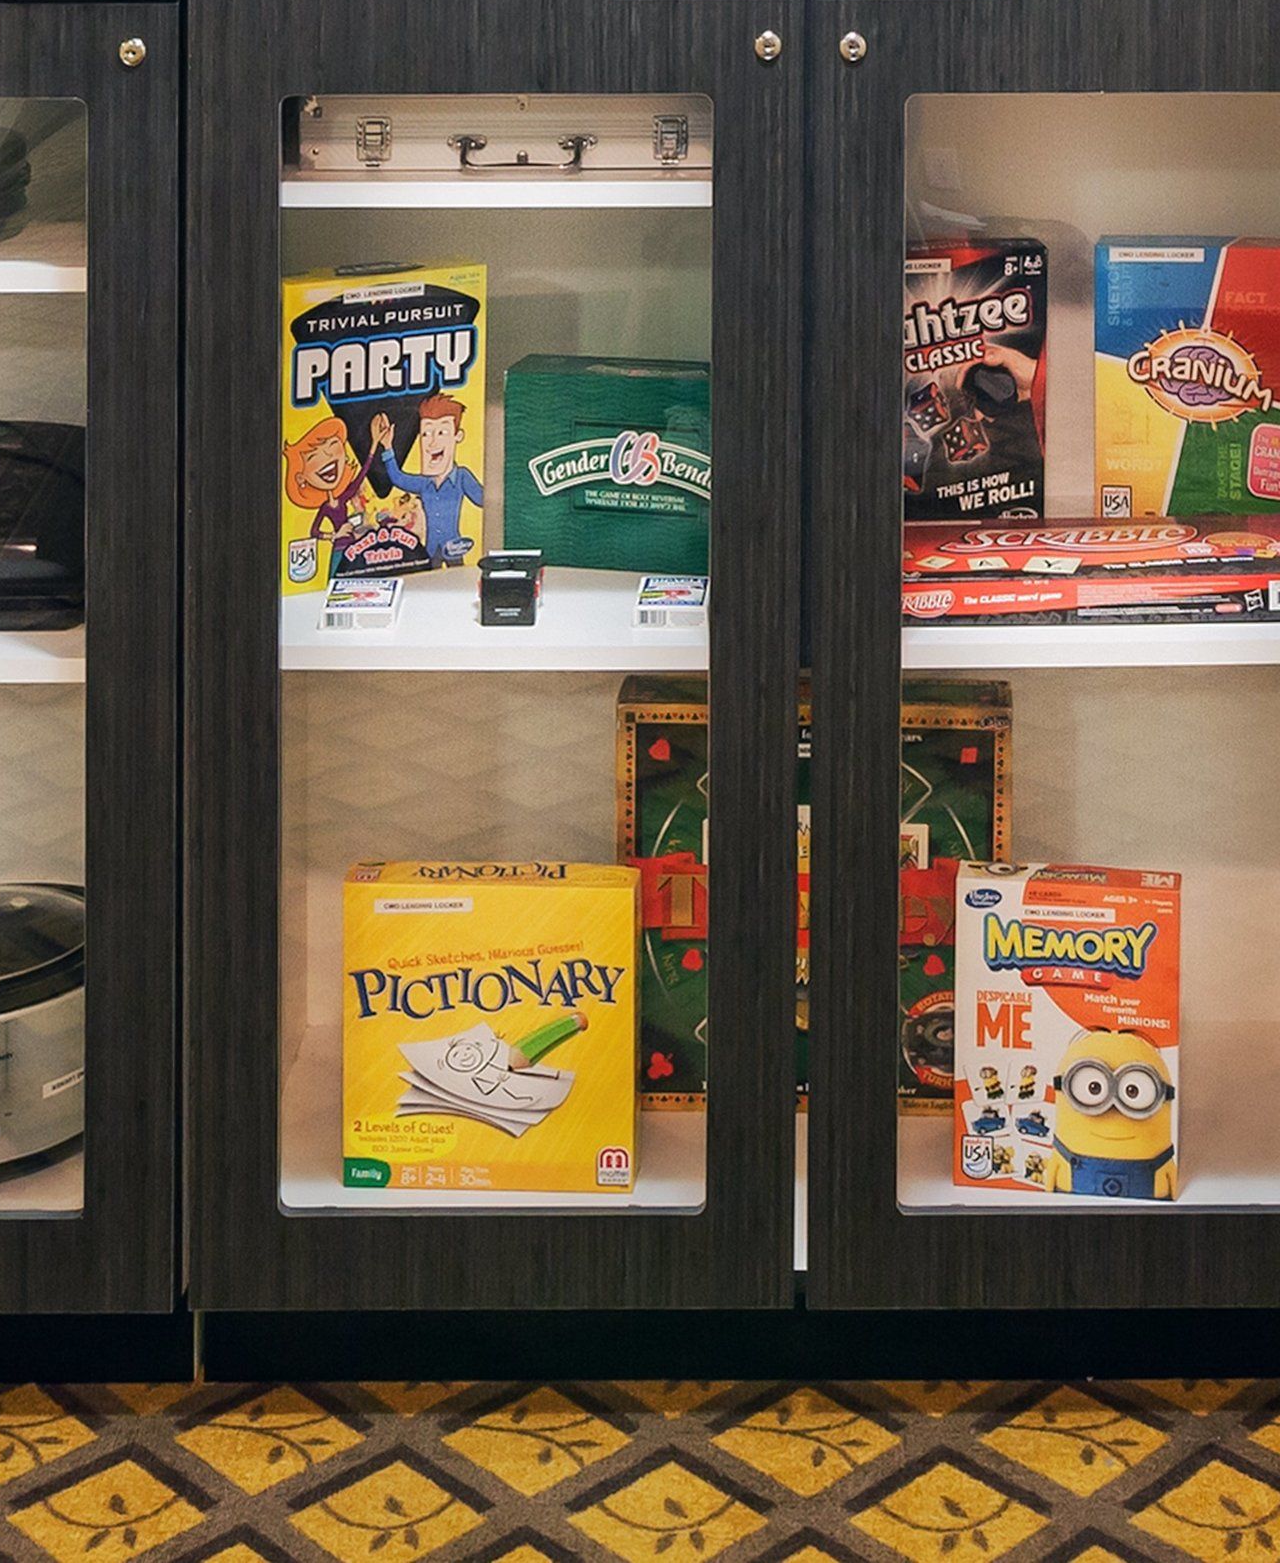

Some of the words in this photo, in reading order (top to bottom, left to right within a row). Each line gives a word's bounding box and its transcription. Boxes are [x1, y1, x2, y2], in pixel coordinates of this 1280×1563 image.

[363, 289, 393, 299] LENDING
[395, 286, 423, 296] LOCKER
[1224, 291, 1268, 305] FACT
[306, 313, 380, 334] TRIVIAL
[384, 303, 465, 325] PURSUIT
[905, 338, 985, 373] CLASSIC
[296, 329, 471, 401] PARTY
[542, 450, 610, 485] Gender
[660, 451, 712, 488] Bend
[936, 481, 966, 499] THIS
[967, 479, 980, 493] IS
[981, 471, 1010, 489] HOW
[958, 491, 986, 512] WE
[988, 480, 1035, 506] ROLL!
[1104, 494, 1129, 511] USA
[344, 533, 376, 561] Fast
[377, 528, 389, 543] &
[390, 527, 419, 550] Fun
[963, 528, 1187, 547] SCRABBLE
[290, 547, 315, 567] USA
[363, 545, 403, 565] Trivia
[963, 596, 978, 605] The
[979, 594, 1016, 604] CLASSIC
[1017, 592, 1038, 602] word
[1039, 592, 1063, 603] game
[434, 901, 464, 910] LOCKER
[1102, 894, 1126, 904] AGES
[1075, 911, 1105, 919] LOCKER
[986, 915, 1154, 969] MEMORY
[387, 957, 421, 970] Quick
[425, 951, 486, 967] Sketches,
[488, 946, 535, 960] Hilarious
[537, 939, 585, 956] Guesses!
[1031, 968, 1103, 983] GAME
[348, 957, 626, 1020] PICTIONARY
[976, 990, 1033, 1004] DESPICABLE
[1083, 993, 1118, 1005] Match
[1119, 998, 1142, 1008] your
[1101, 1004, 1137, 1016] favorite
[976, 1003, 1034, 1050] ME
[1117, 1015, 1171, 1029] MINIONS!
[353, 1120, 362, 1132] 2
[365, 1121, 400, 1134] Levels
[403, 1120, 417, 1134] of
[419, 1122, 455, 1135] Clues!
[964, 1144, 992, 1162] USA
[351, 1167, 382, 1181] Family
